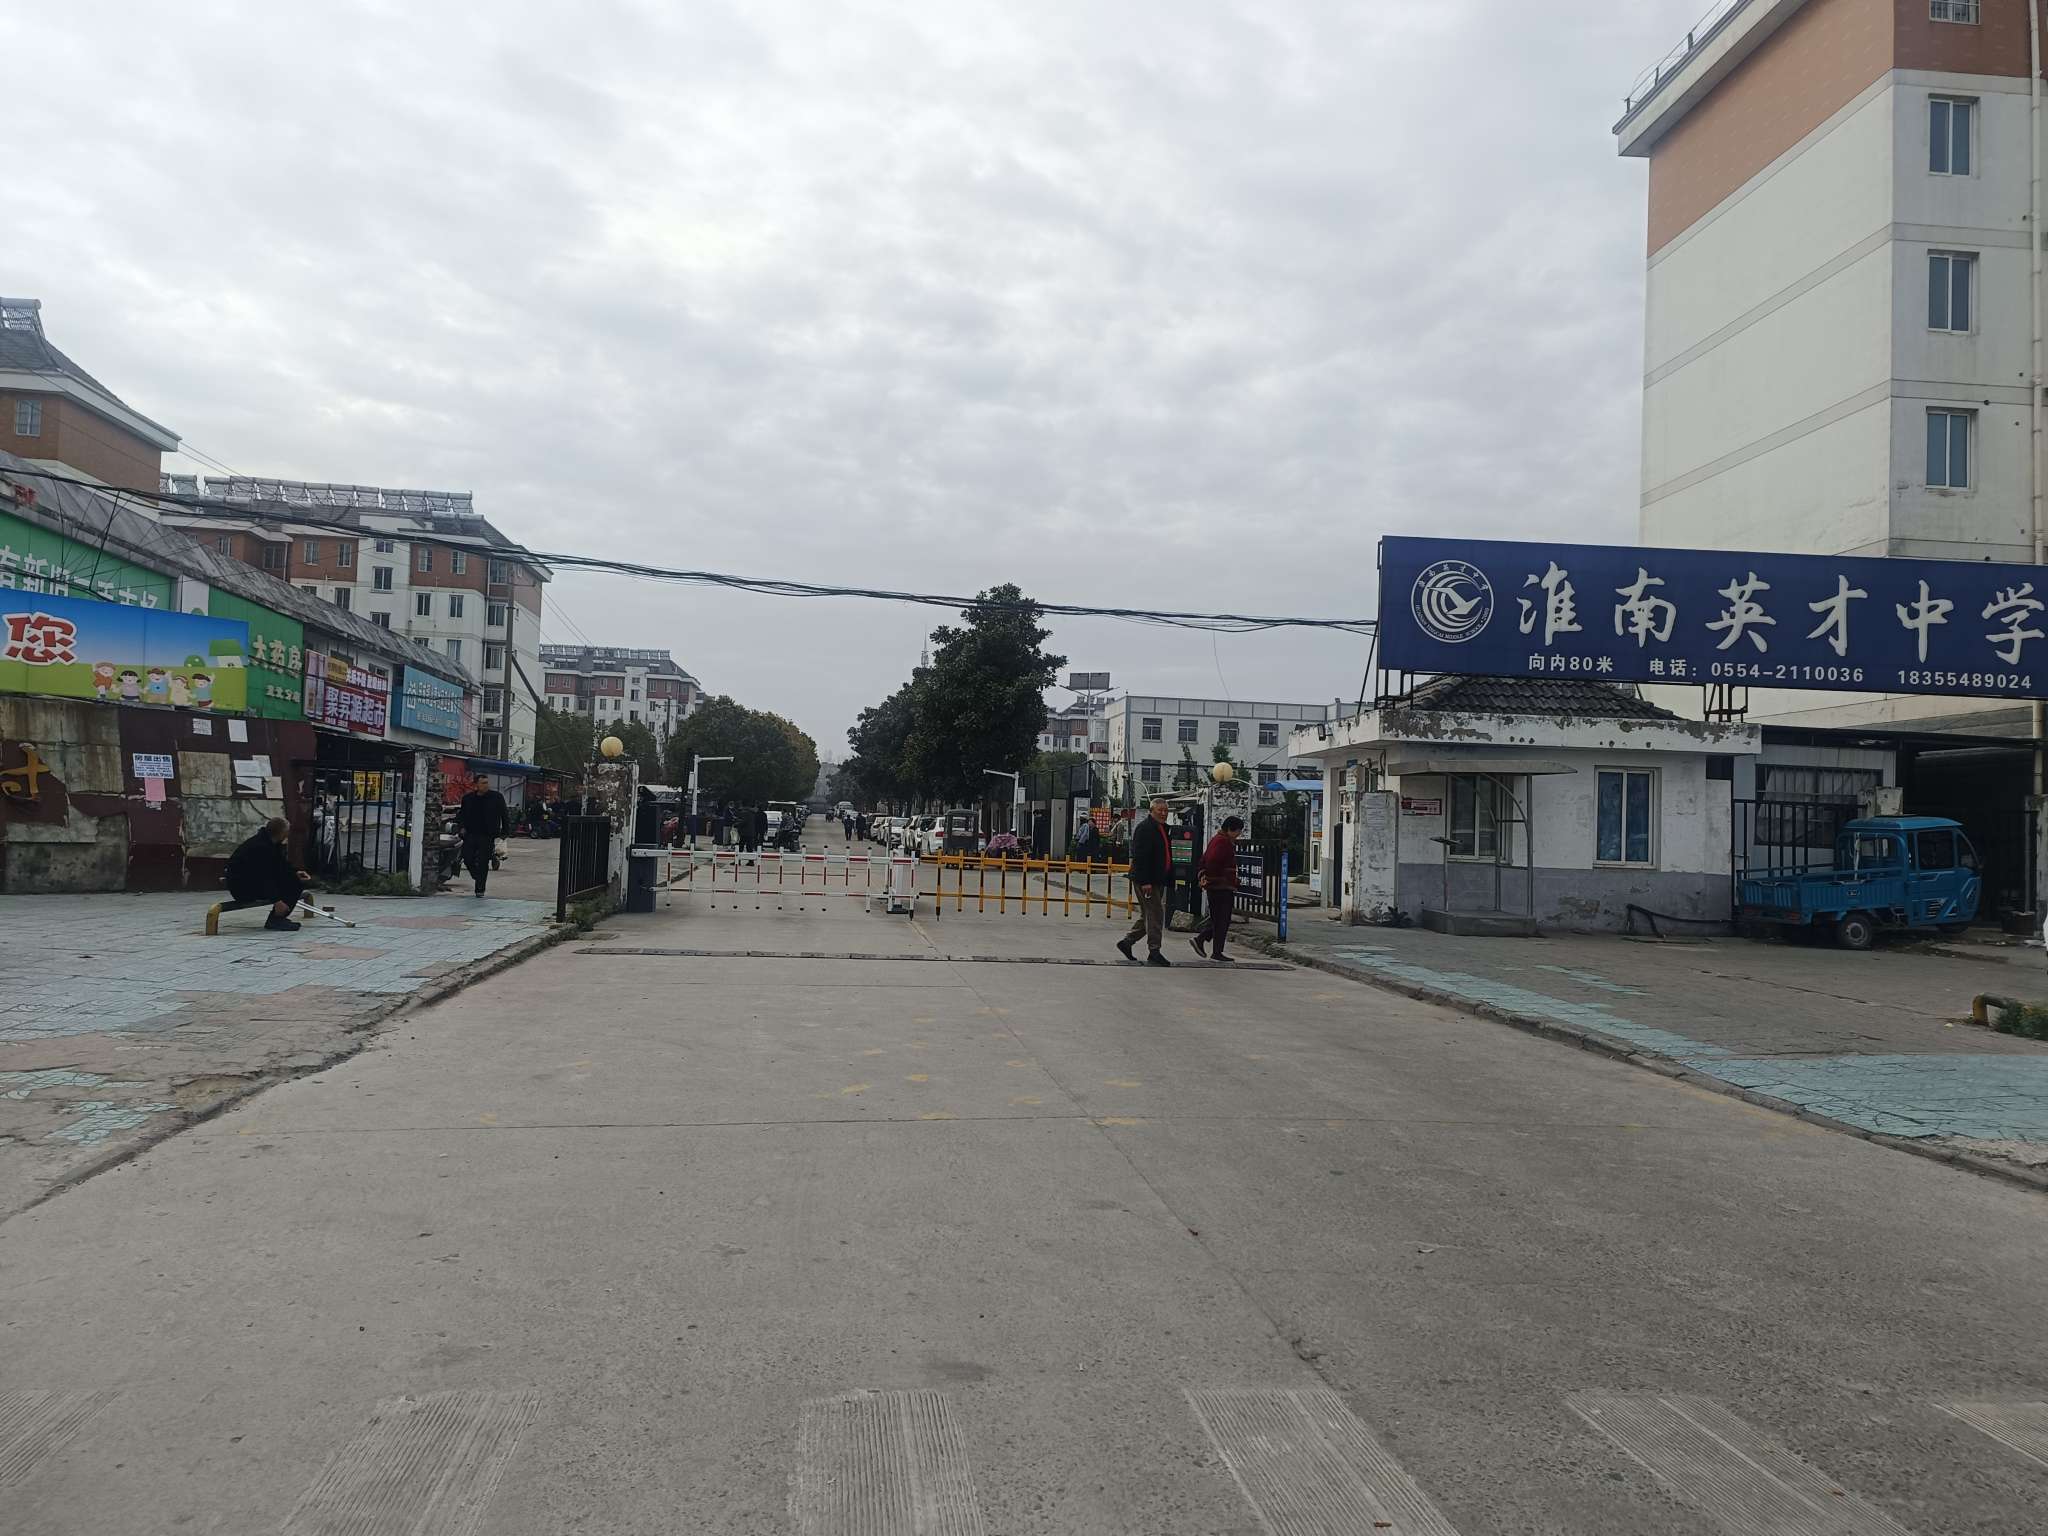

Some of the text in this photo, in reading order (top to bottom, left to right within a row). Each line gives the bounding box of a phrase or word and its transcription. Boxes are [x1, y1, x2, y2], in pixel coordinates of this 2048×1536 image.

[1515, 561, 2046, 664] 淮南英才中学
[2, 612, 77, 666] 您
[252, 634, 303, 672] 大药房
[1528, 652, 1614, 674] 向内80米
[1711, 661, 1864, 682] 0554-2110036
[1898, 669, 2032, 690] 18355489024
